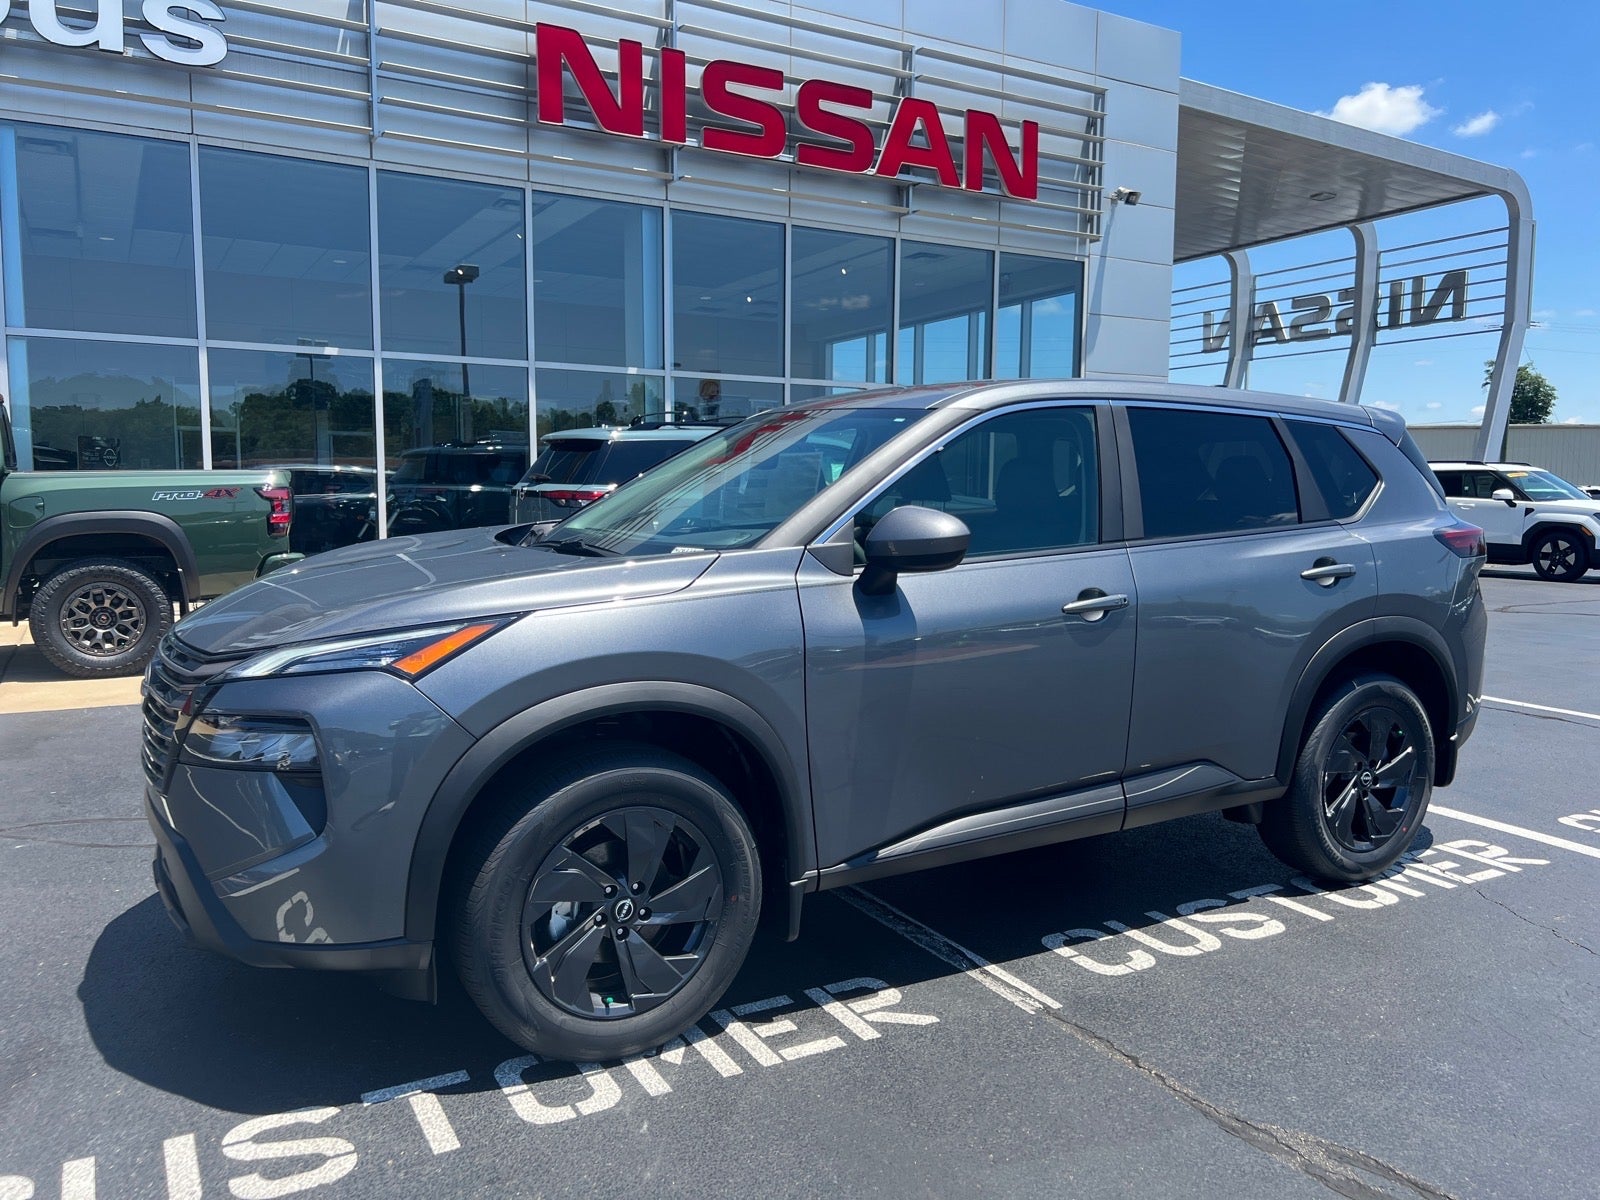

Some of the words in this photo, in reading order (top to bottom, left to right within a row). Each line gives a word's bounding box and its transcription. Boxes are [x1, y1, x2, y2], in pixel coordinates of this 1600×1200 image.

[0, 0, 228, 66] us
[536, 22, 1038, 200] NISSAN
[1041, 839, 1550, 976] CUSTOMER
[0, 977, 940, 1200] USTOMER
